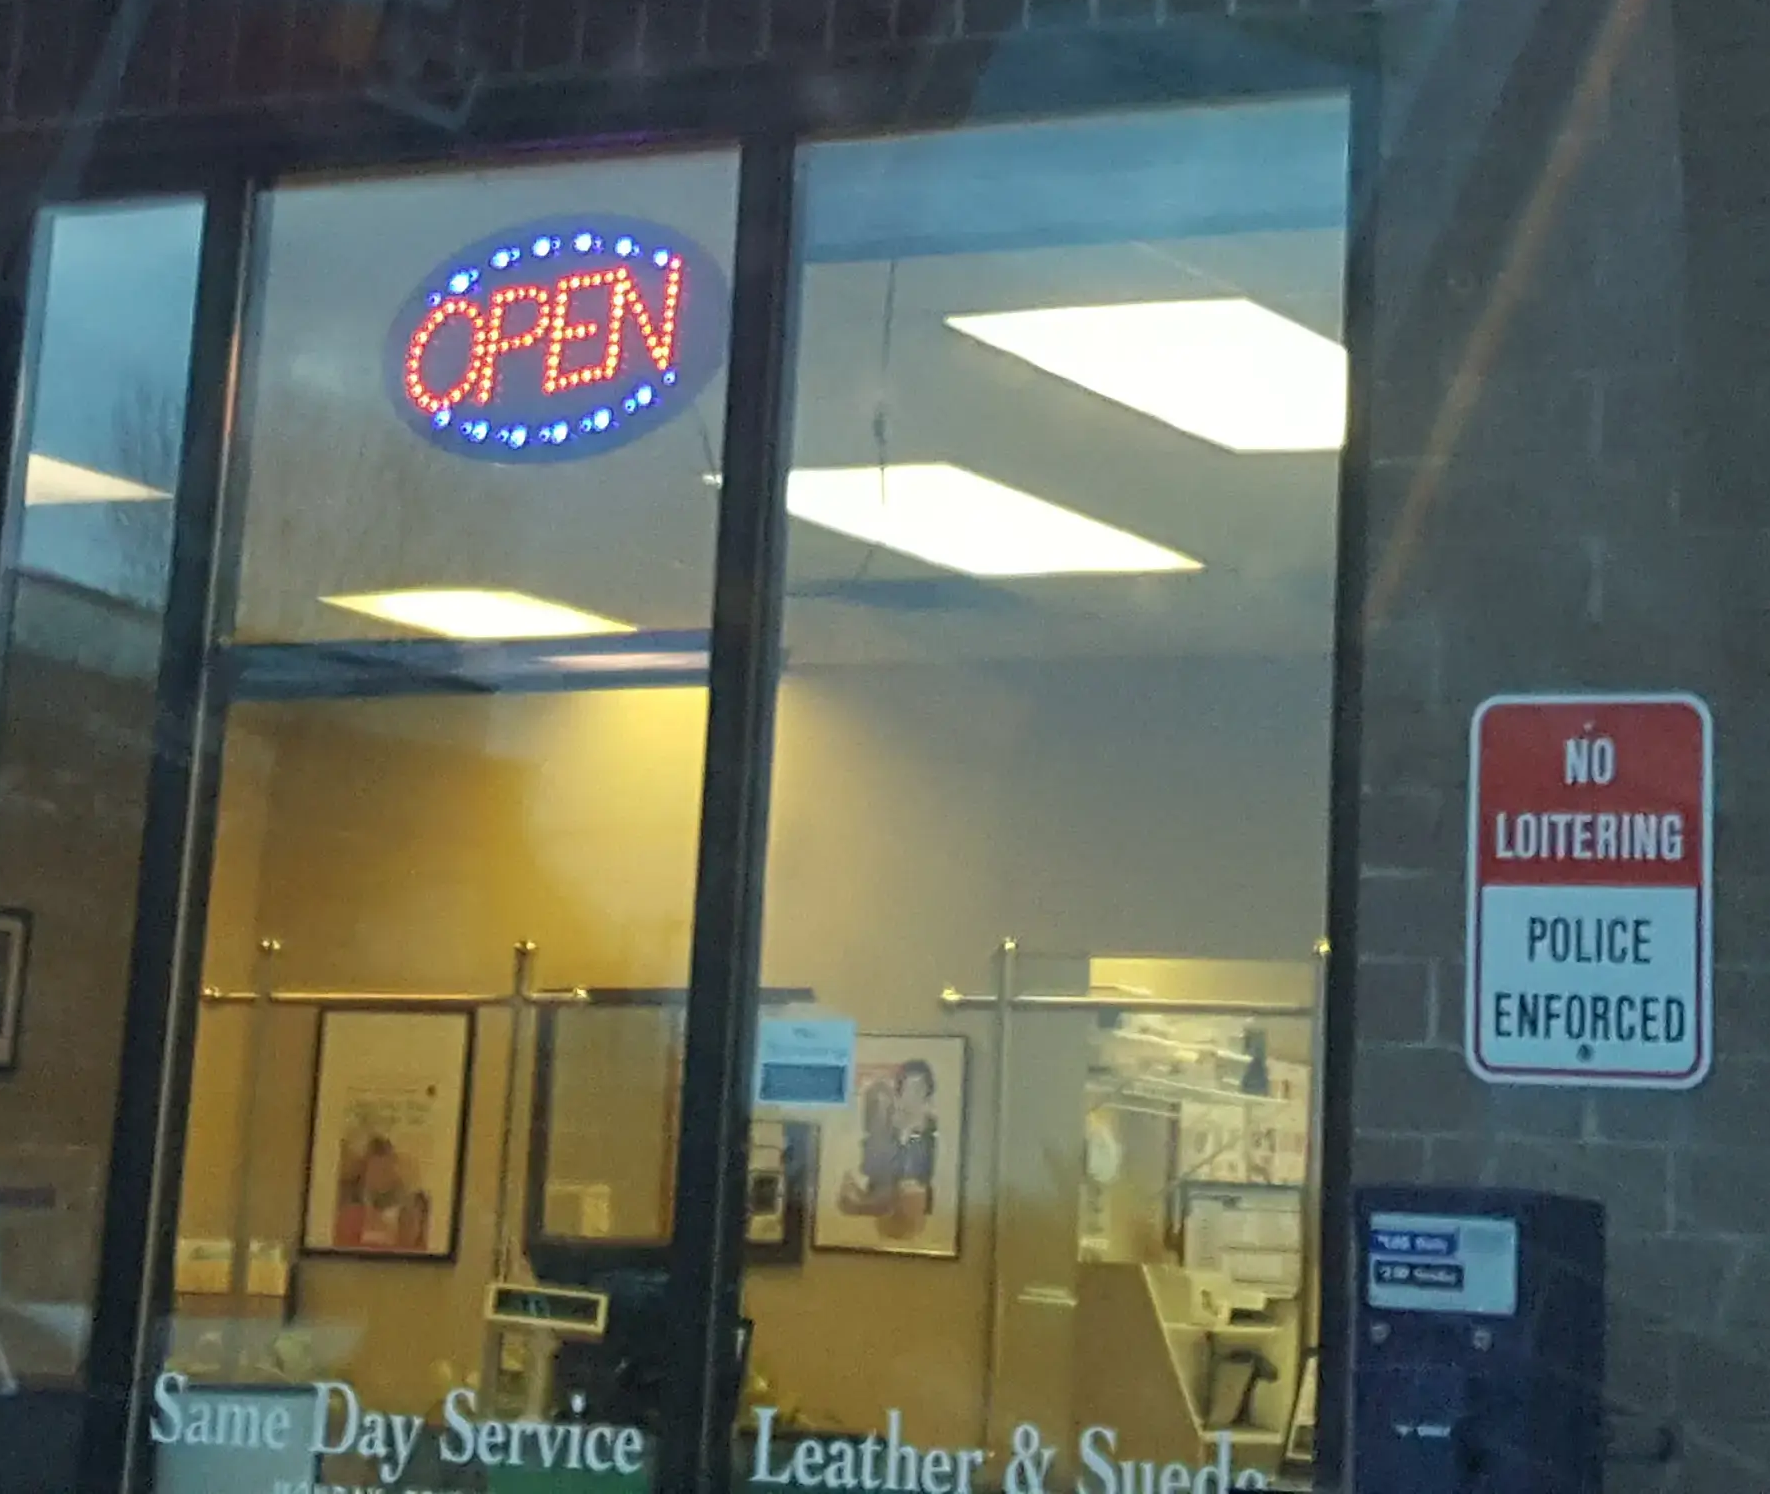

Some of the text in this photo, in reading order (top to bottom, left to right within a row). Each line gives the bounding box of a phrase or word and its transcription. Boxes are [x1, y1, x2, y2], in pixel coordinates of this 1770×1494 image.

[405, 254, 683, 414] OPEN
[1564, 737, 1615, 786] NO
[1494, 812, 1685, 862] LOITERING
[1527, 915, 1653, 966] POLICE
[1493, 991, 1686, 1044] ENFORCED
[149, 1372, 646, 1483] Same Day Service
[749, 1407, 985, 1494] Leather
[1004, 1422, 1060, 1494] &
